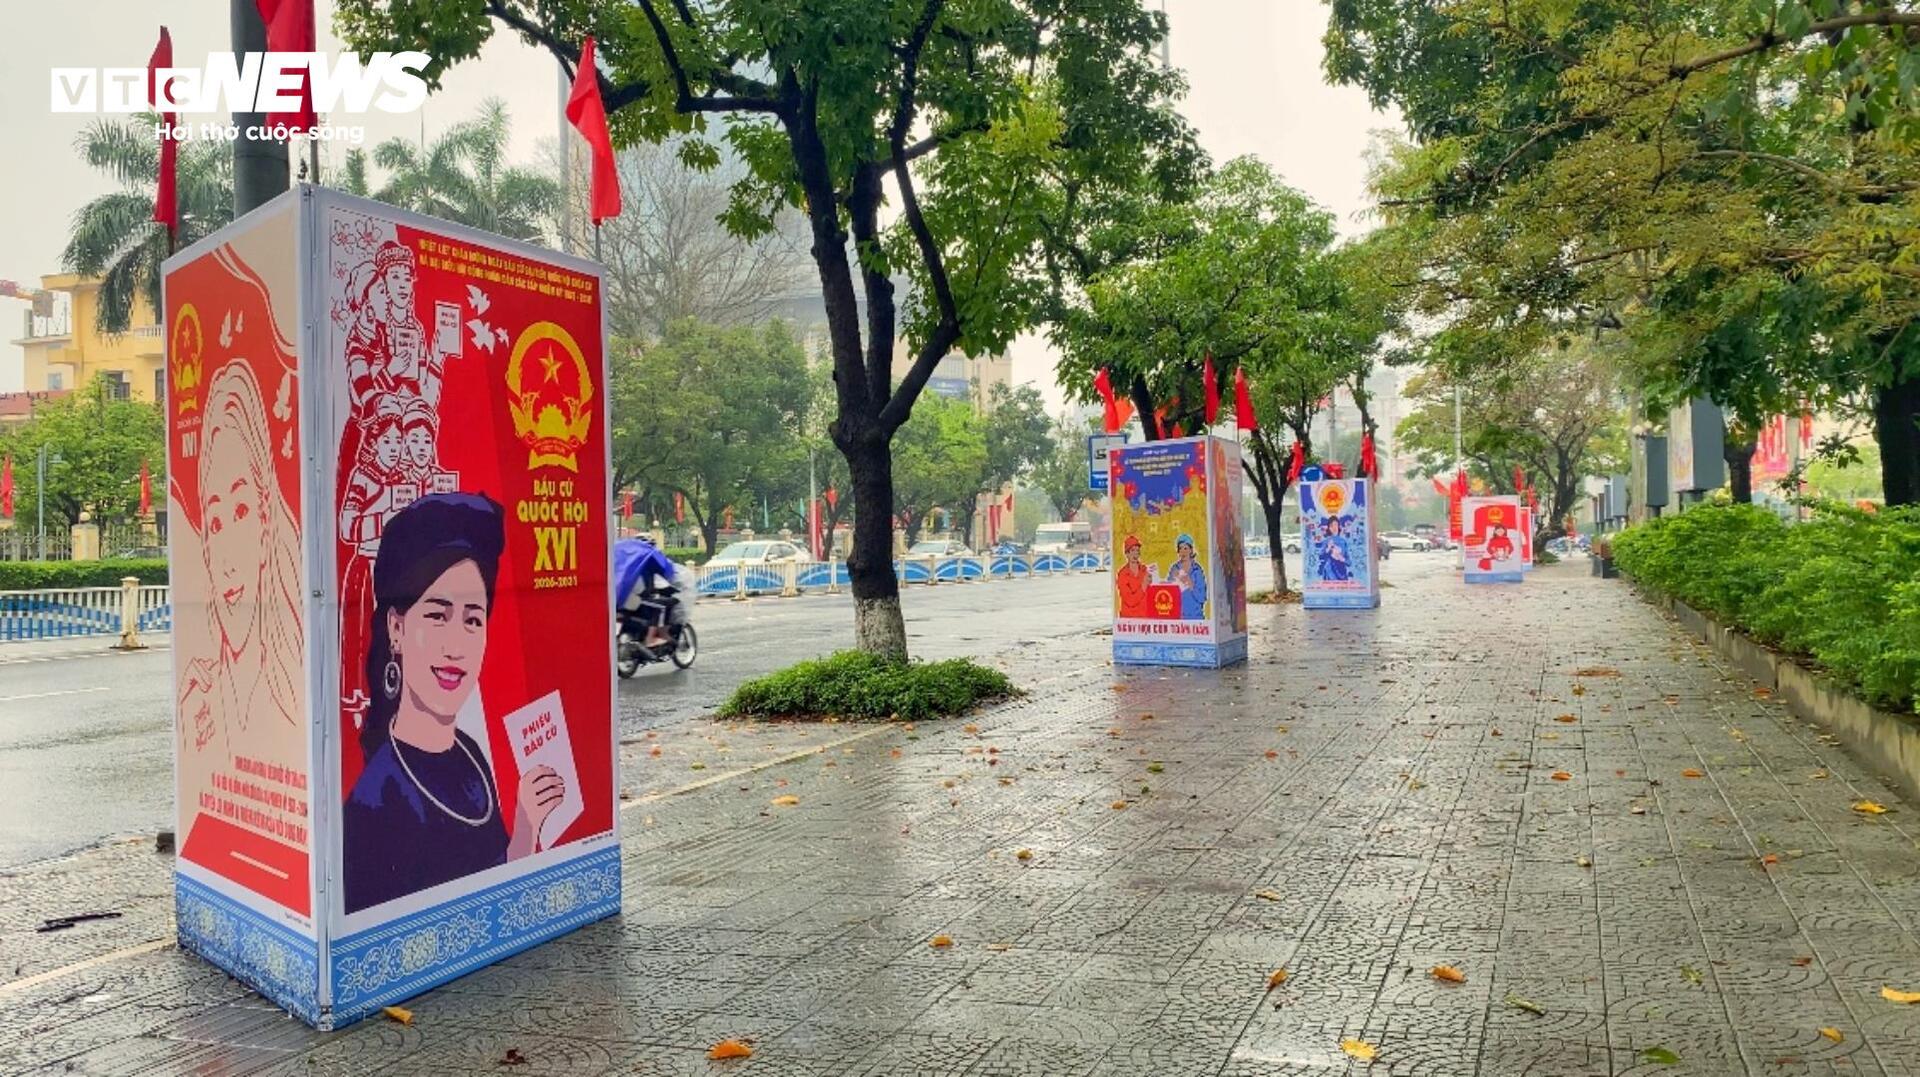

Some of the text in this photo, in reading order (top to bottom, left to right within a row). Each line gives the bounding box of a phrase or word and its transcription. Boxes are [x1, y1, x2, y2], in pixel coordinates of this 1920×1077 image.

[533, 475, 574, 499] BẦU CỬ
[517, 498, 588, 527] QUỐC HỘI
[533, 526, 577, 571] XVI
